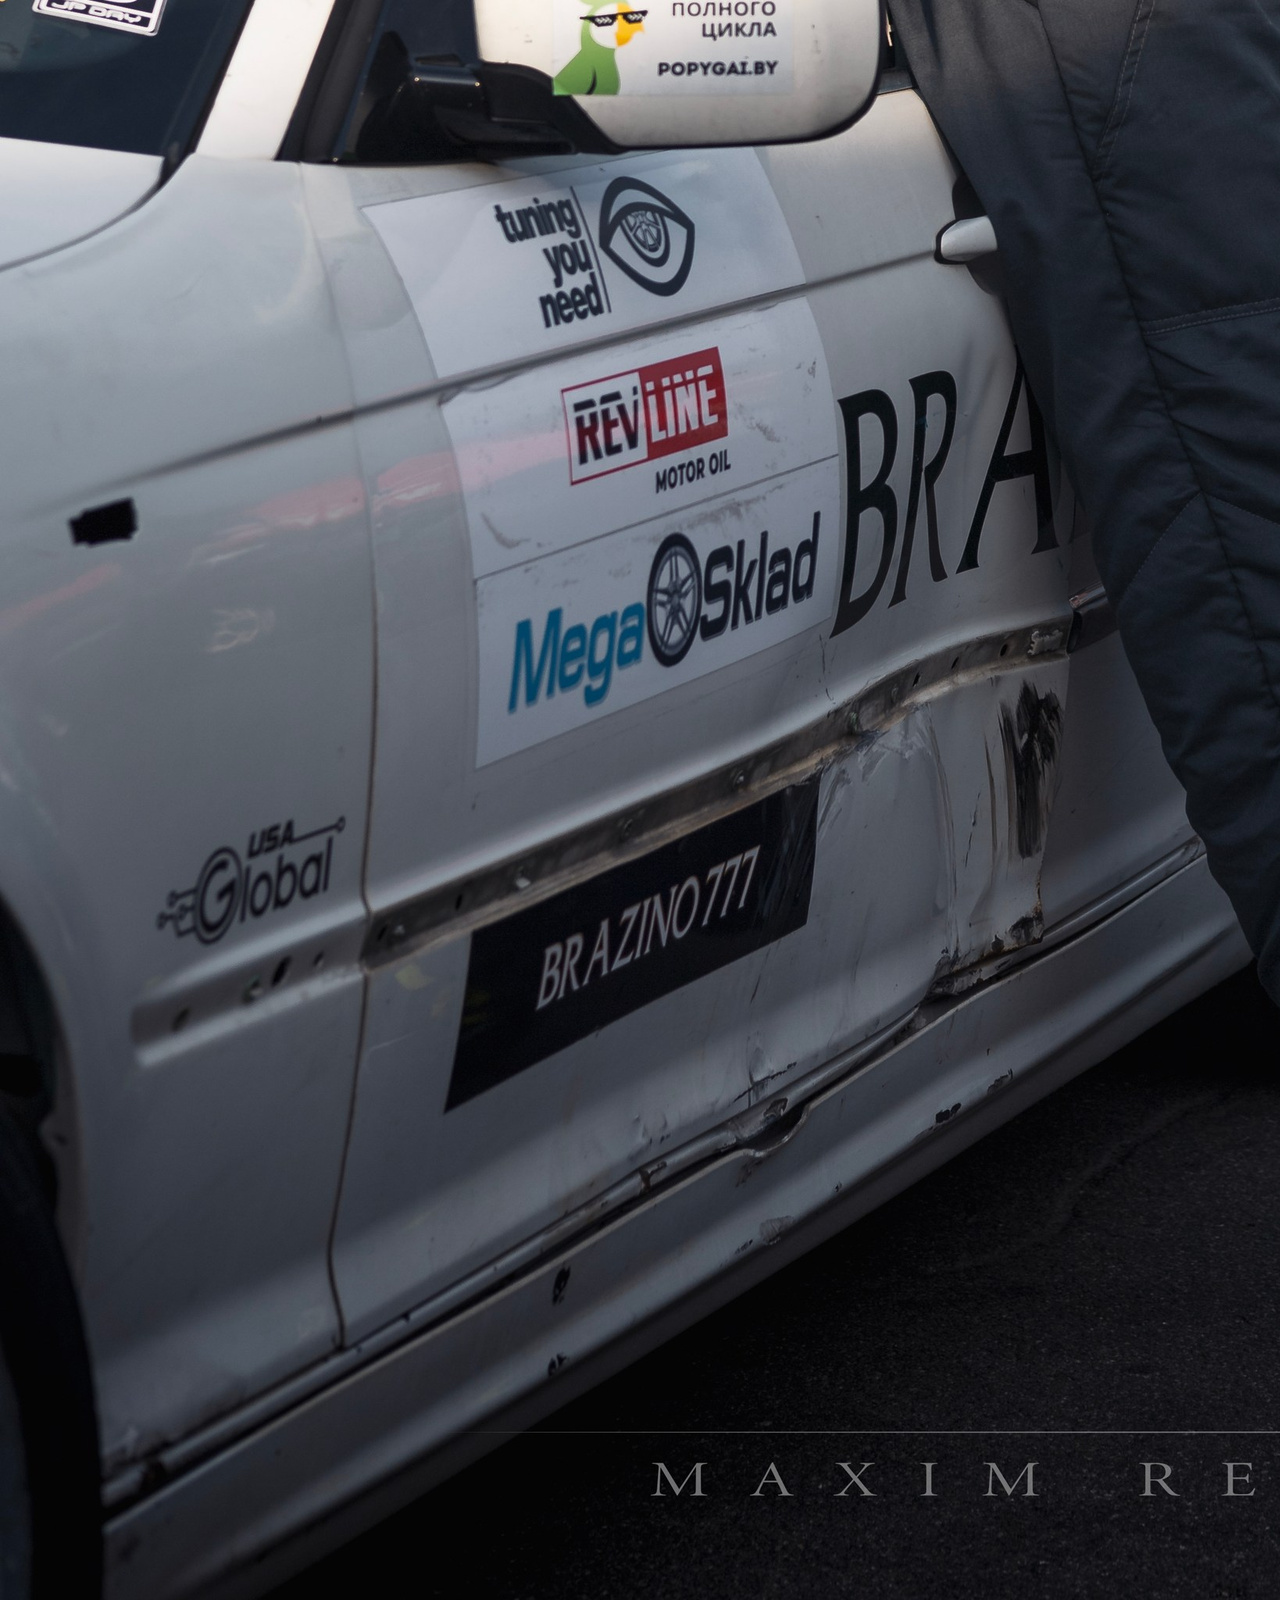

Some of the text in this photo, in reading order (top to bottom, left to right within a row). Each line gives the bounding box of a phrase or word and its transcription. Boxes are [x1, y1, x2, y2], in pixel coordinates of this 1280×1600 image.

[671, 1, 777, 17] ПОЛНОГО
[701, 22, 777, 41] ЦИКЛА
[494, 197, 582, 244] tuning
[542, 239, 593, 288] you
[538, 271, 605, 329] need
[655, 449, 731, 494] MOTOR OIL
[247, 819, 294, 859] USA
[200, 836, 334, 933] Global
